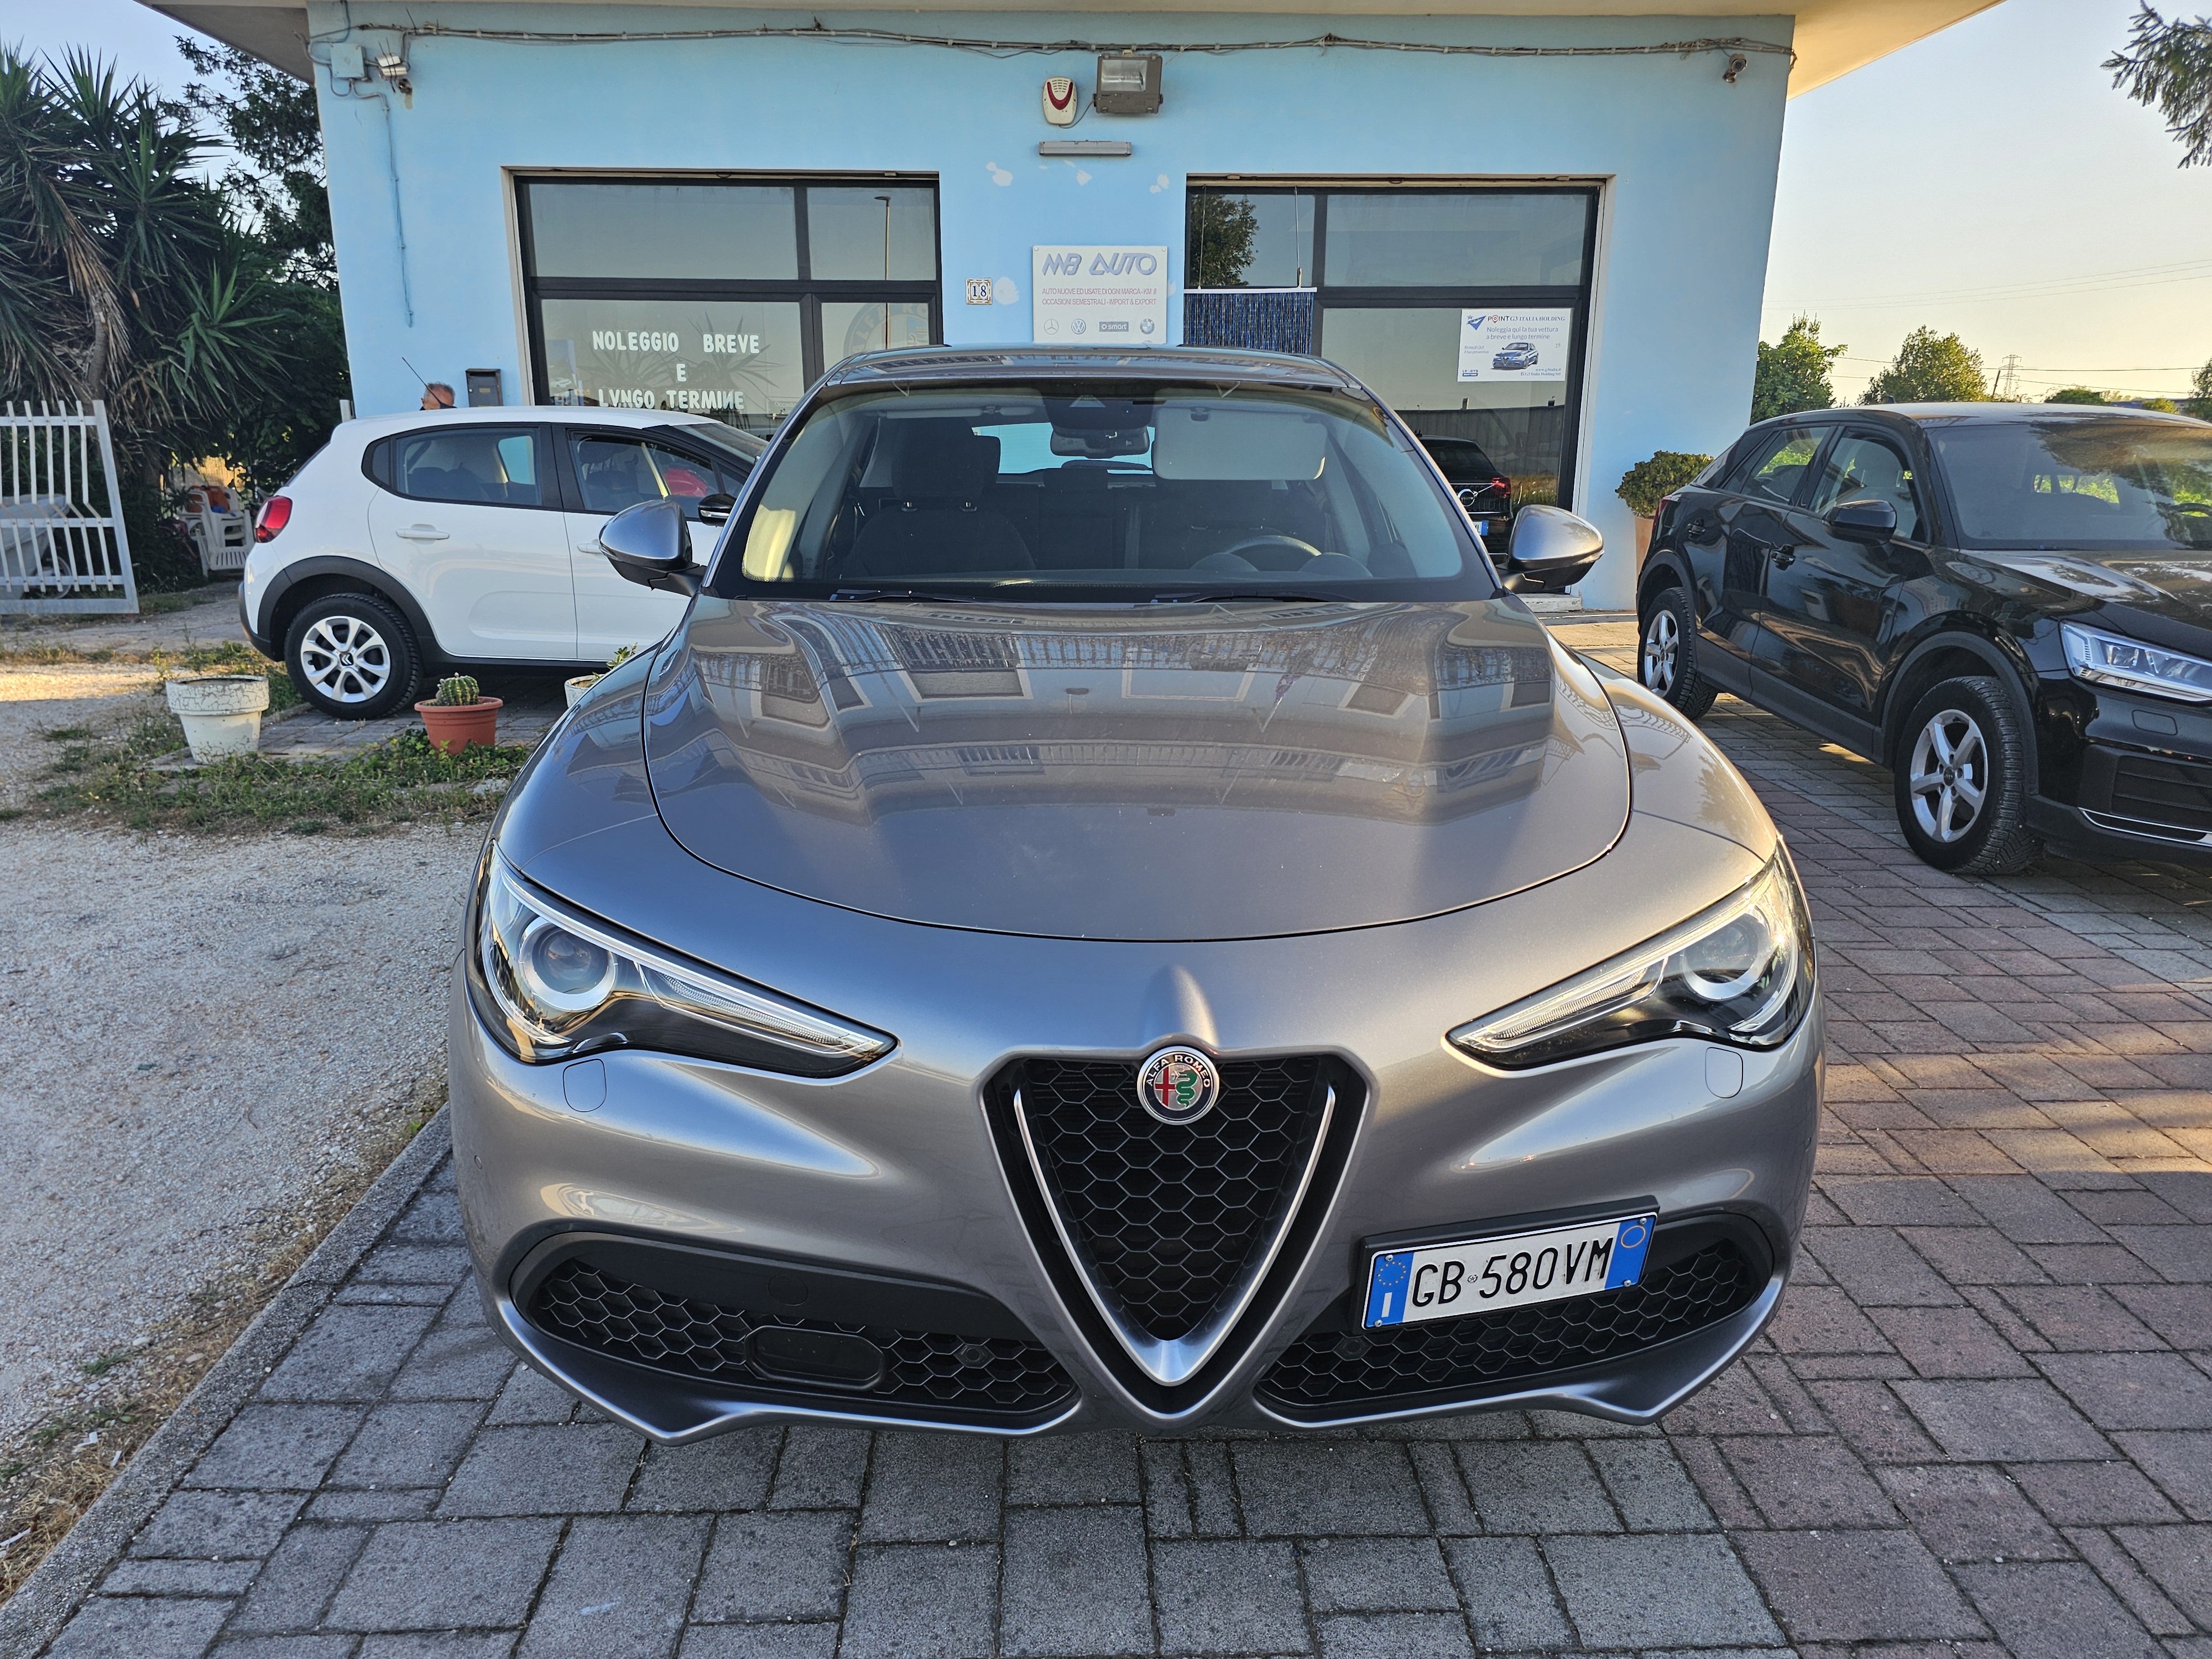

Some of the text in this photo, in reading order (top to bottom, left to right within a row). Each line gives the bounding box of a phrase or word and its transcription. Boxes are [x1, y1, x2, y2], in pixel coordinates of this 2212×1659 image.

[1089, 253, 1157, 275] AUTO
[972, 285, 987, 298] 18
[1488, 315, 1510, 323] POINT
[593, 331, 760, 354] NOLEGGIO BREVE
[676, 363, 687, 382] E
[666, 390, 744, 410] TERMINE
[1146, 1055, 1211, 1088] ALFA ROMEO
[1411, 1236, 1614, 1307] GB 580VM
